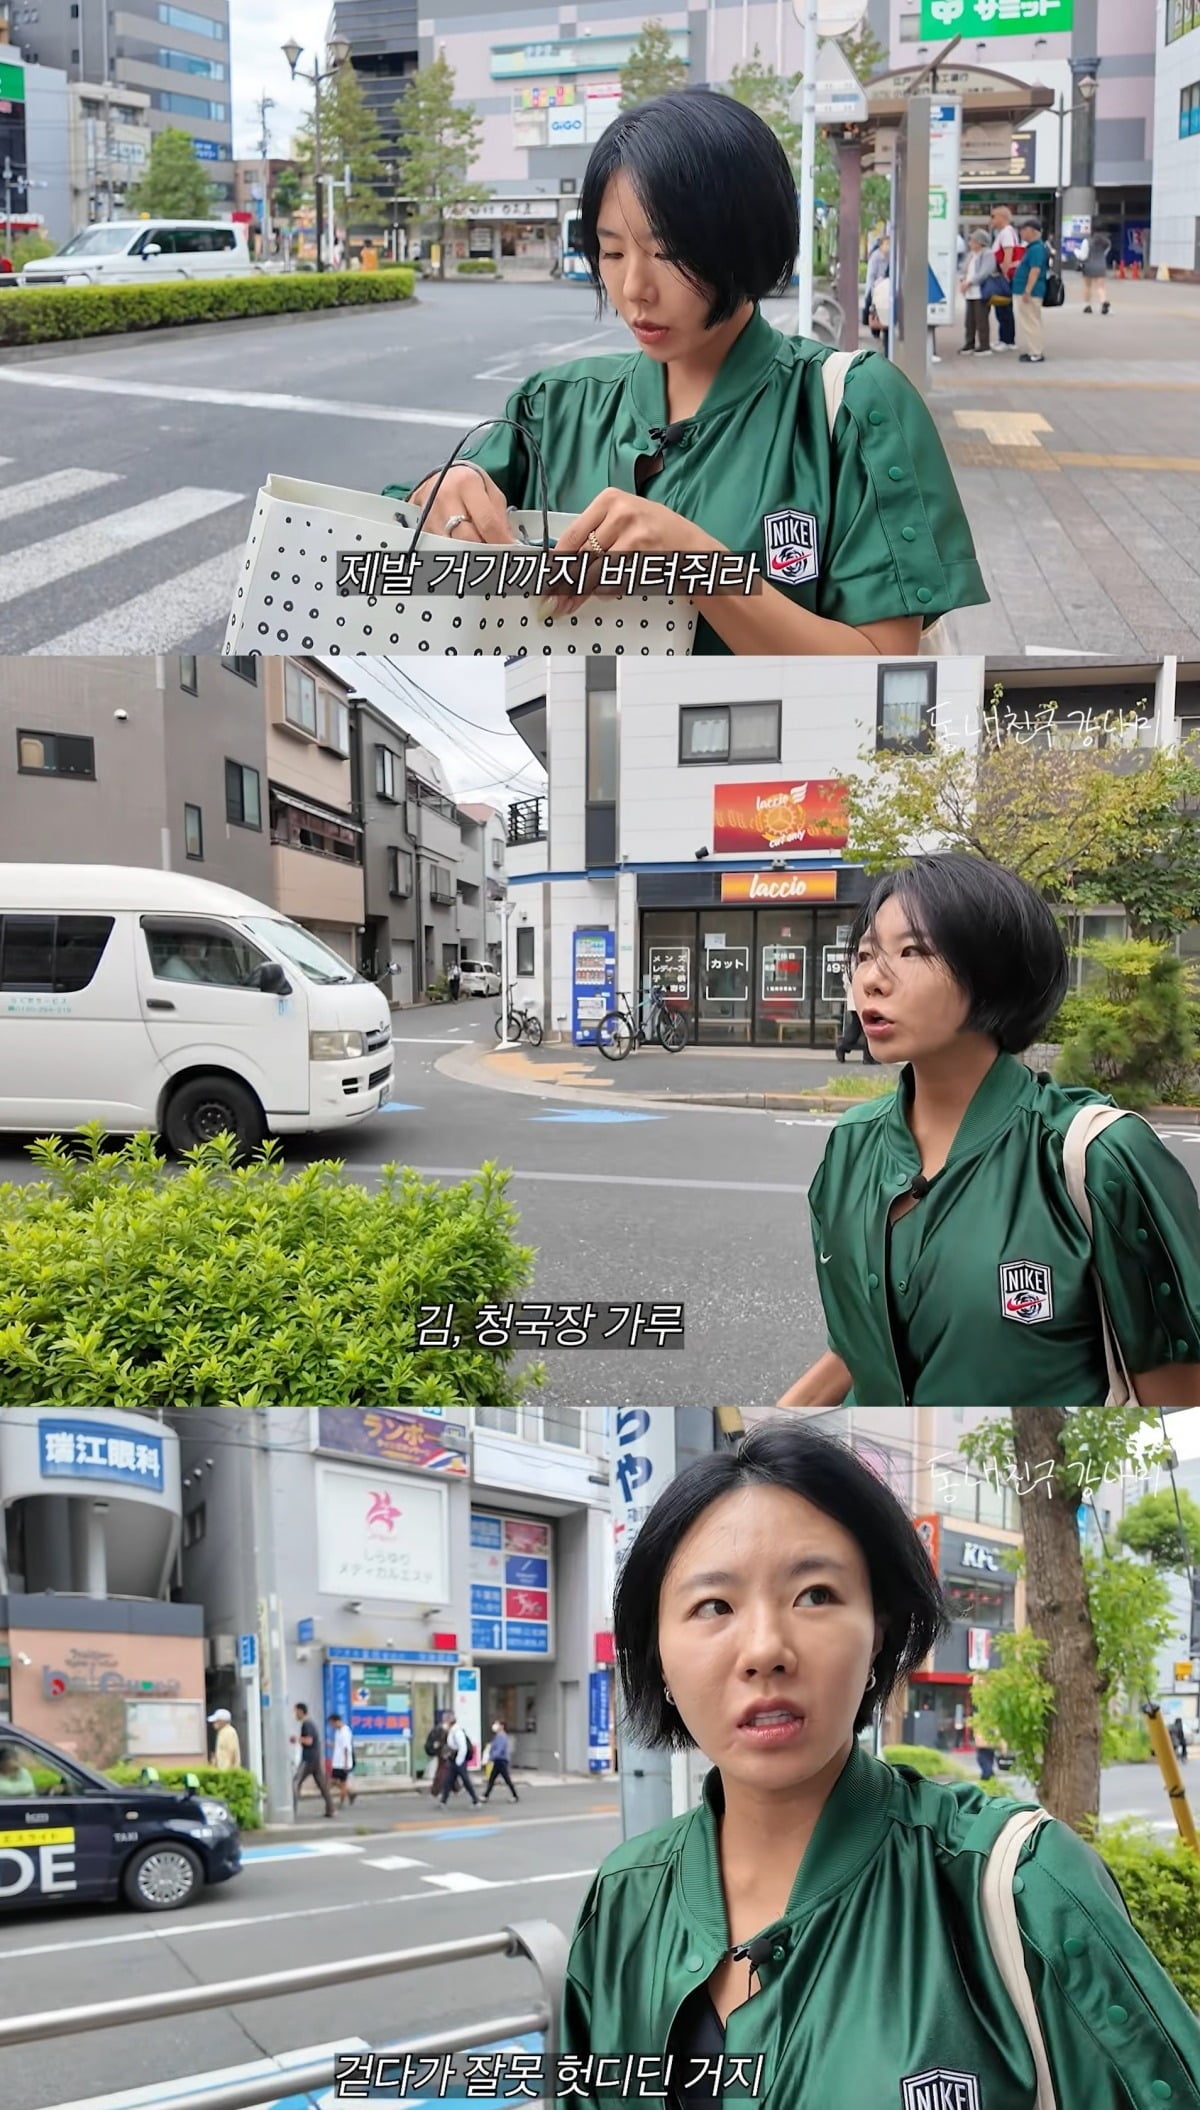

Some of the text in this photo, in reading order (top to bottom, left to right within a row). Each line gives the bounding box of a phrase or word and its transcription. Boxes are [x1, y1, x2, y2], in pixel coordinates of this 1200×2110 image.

[973, 0, 1061, 21] サミット
[773, 518, 809, 547] NIKE
[756, 794, 789, 812] laccio
[768, 829, 806, 848] cut only
[748, 872, 807, 899] laccio
[710, 958, 744, 969] カット
[1008, 1268, 1044, 1292] NIKE
[44, 1431, 161, 1479] 瑞江眼科
[961, 1541, 1000, 1572] KFC
[112, 1831, 139, 1842] TAXI
